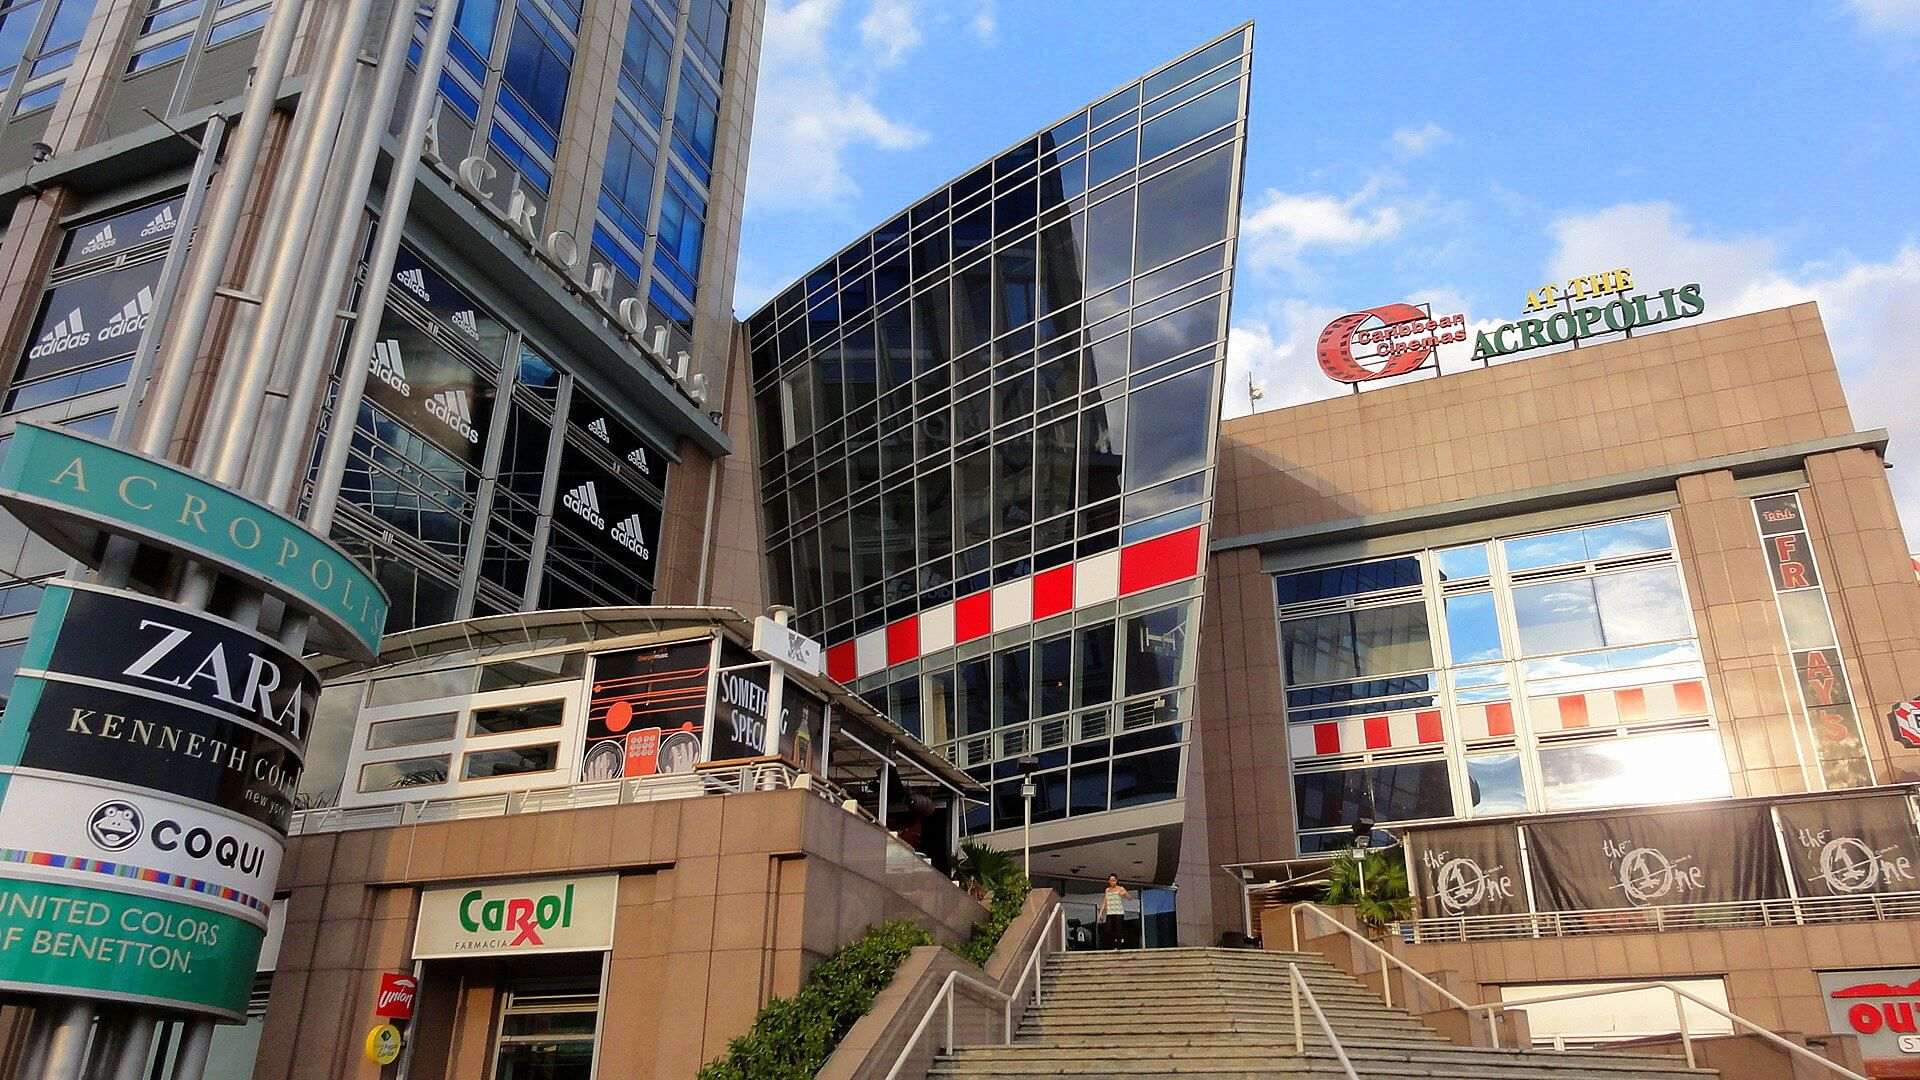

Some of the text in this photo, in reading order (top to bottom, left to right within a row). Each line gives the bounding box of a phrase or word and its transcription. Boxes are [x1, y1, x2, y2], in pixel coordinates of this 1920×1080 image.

[141, 219, 177, 237] adidas
[81, 238, 117, 255] adidas
[397, 272, 430, 302] adidas
[1524, 269, 1634, 312] AT THE
[452, 315, 479, 341] adidas
[1358, 314, 1464, 345] Caribbean
[1472, 284, 1704, 361] ACROPOLIS
[29, 332, 91, 359] adidas
[1376, 331, 1466, 356] Cinemas
[368, 358, 411, 398] didas
[424, 398, 479, 444] adidas
[588, 424, 610, 444] adidas
[627, 453, 649, 475] adidas
[563, 494, 605, 531] adidas
[49, 457, 384, 634] ACROPOLIS
[611, 527, 649, 561] adidas
[122, 619, 302, 740] ZARA
[721, 671, 789, 735] SOMETHG
[66, 708, 247, 772] KENNETH
[731, 709, 766, 753] SPECI
[245, 789, 268, 807] new
[151, 819, 265, 878] COQUI
[1603, 839, 1631, 858] the
[1799, 828, 1831, 848] the
[1424, 849, 1449, 869] the
[120, 908, 220, 946] COLORS
[0, 927, 192, 974] F BENETTON.
[455, 940, 507, 950] FARMACIA
